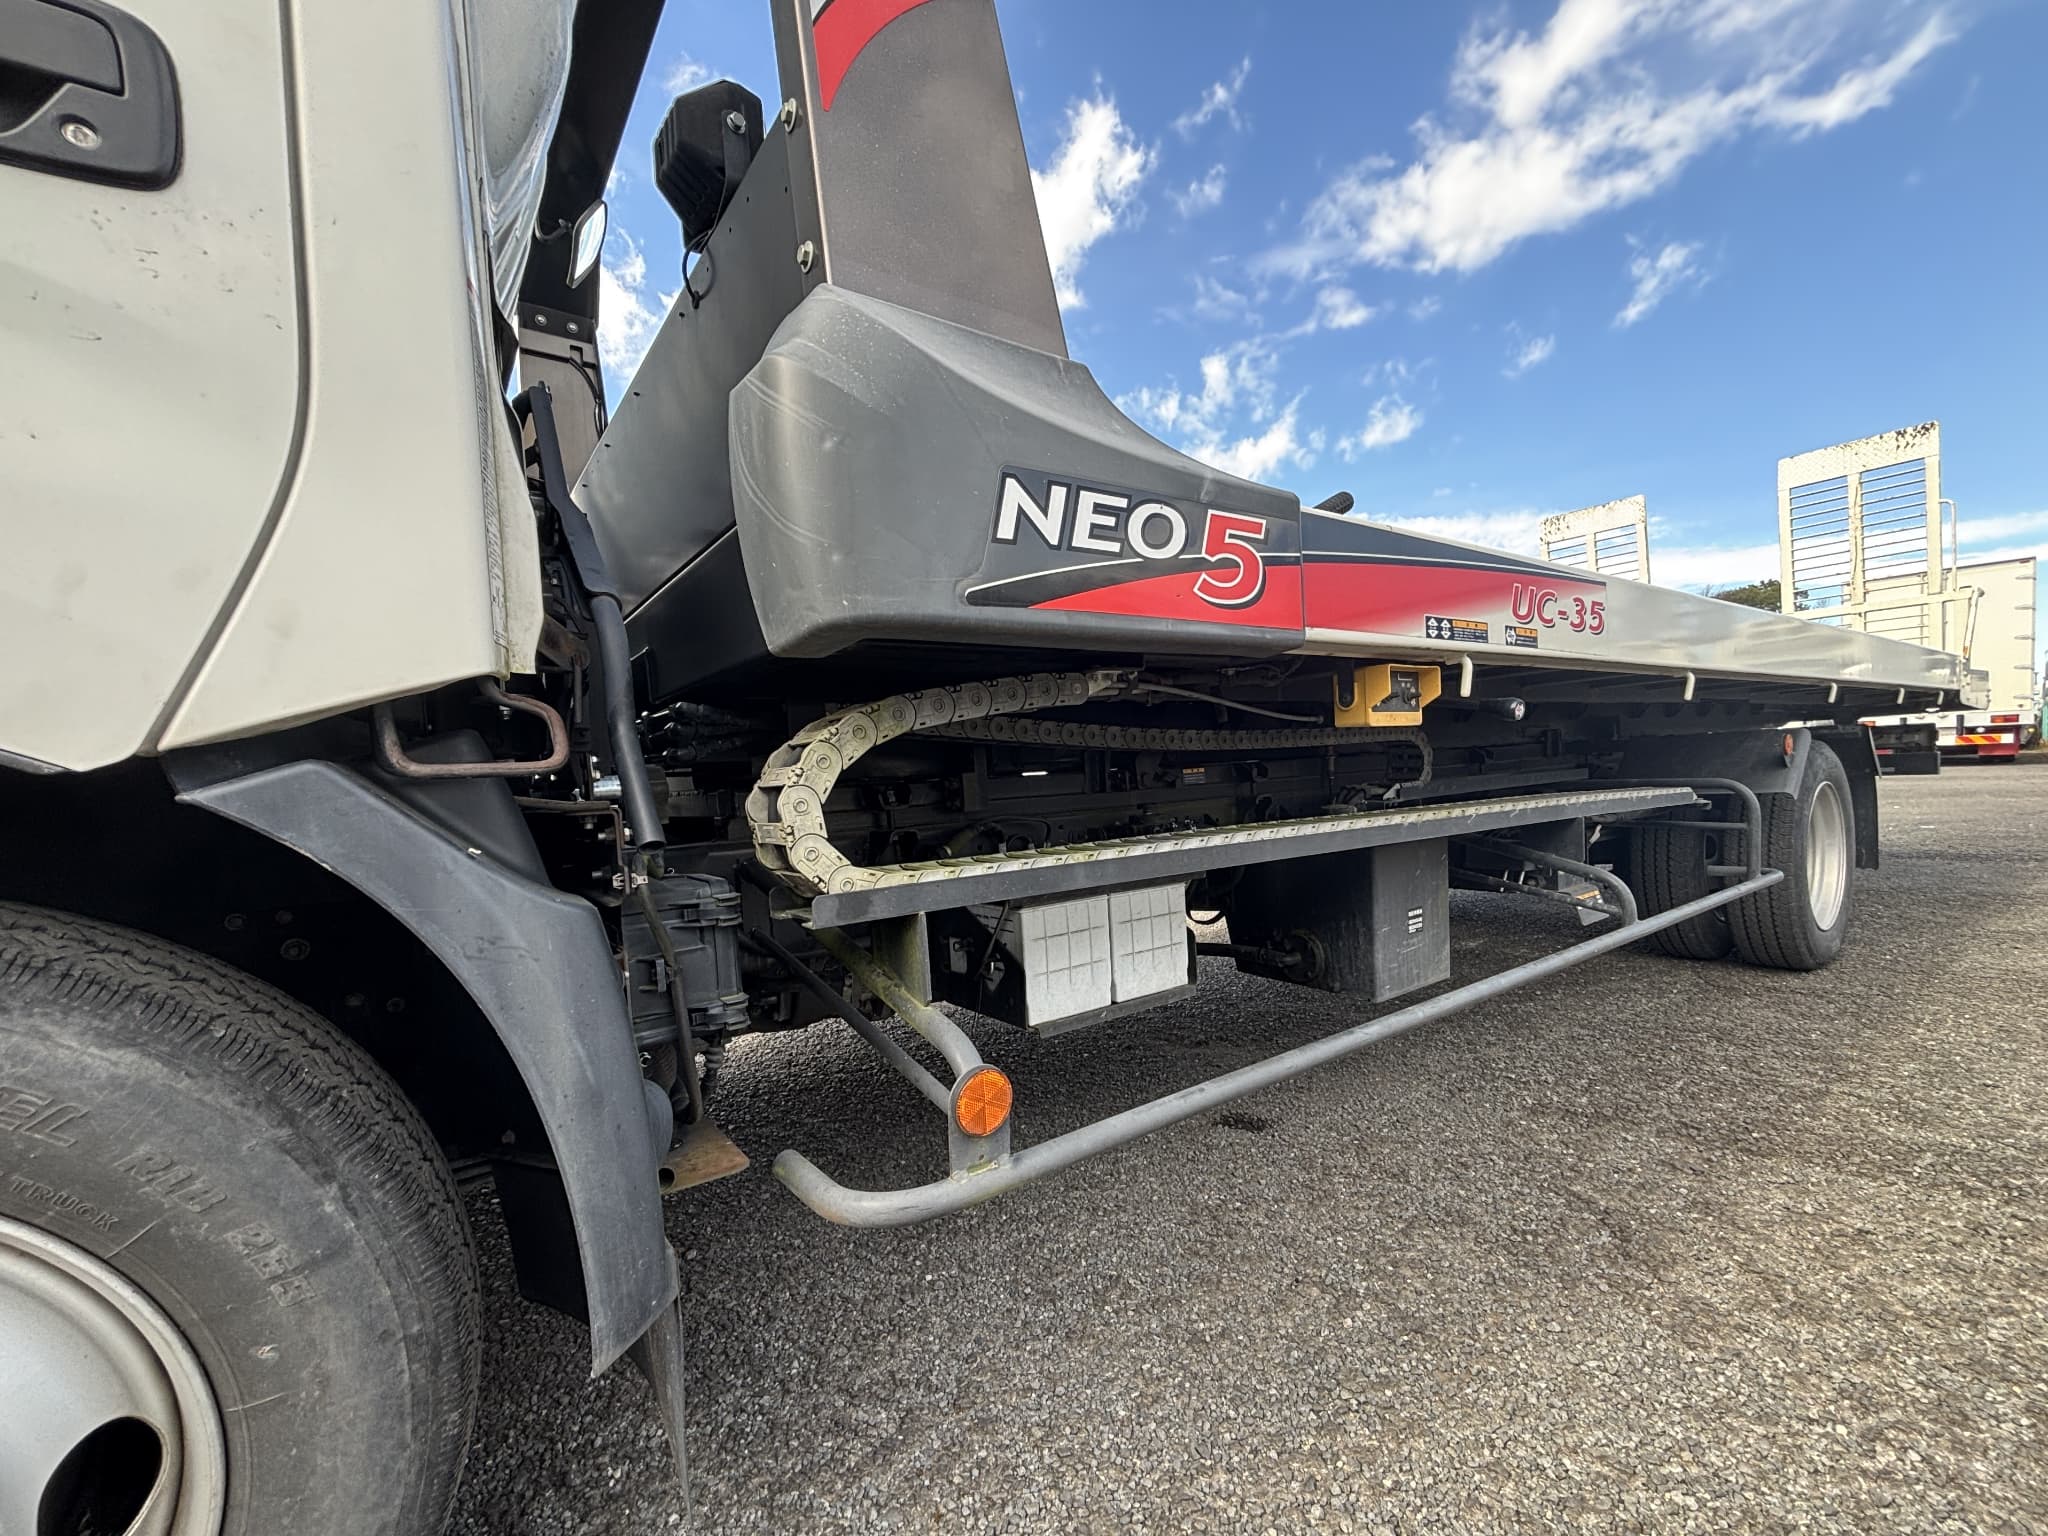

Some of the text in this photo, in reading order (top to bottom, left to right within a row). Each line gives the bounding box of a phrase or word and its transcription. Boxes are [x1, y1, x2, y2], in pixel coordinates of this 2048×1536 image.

[994, 474, 1267, 606] NEO 5
[1511, 582, 1606, 635] UC-35
[9, 1175, 119, 1232] TRUCK
